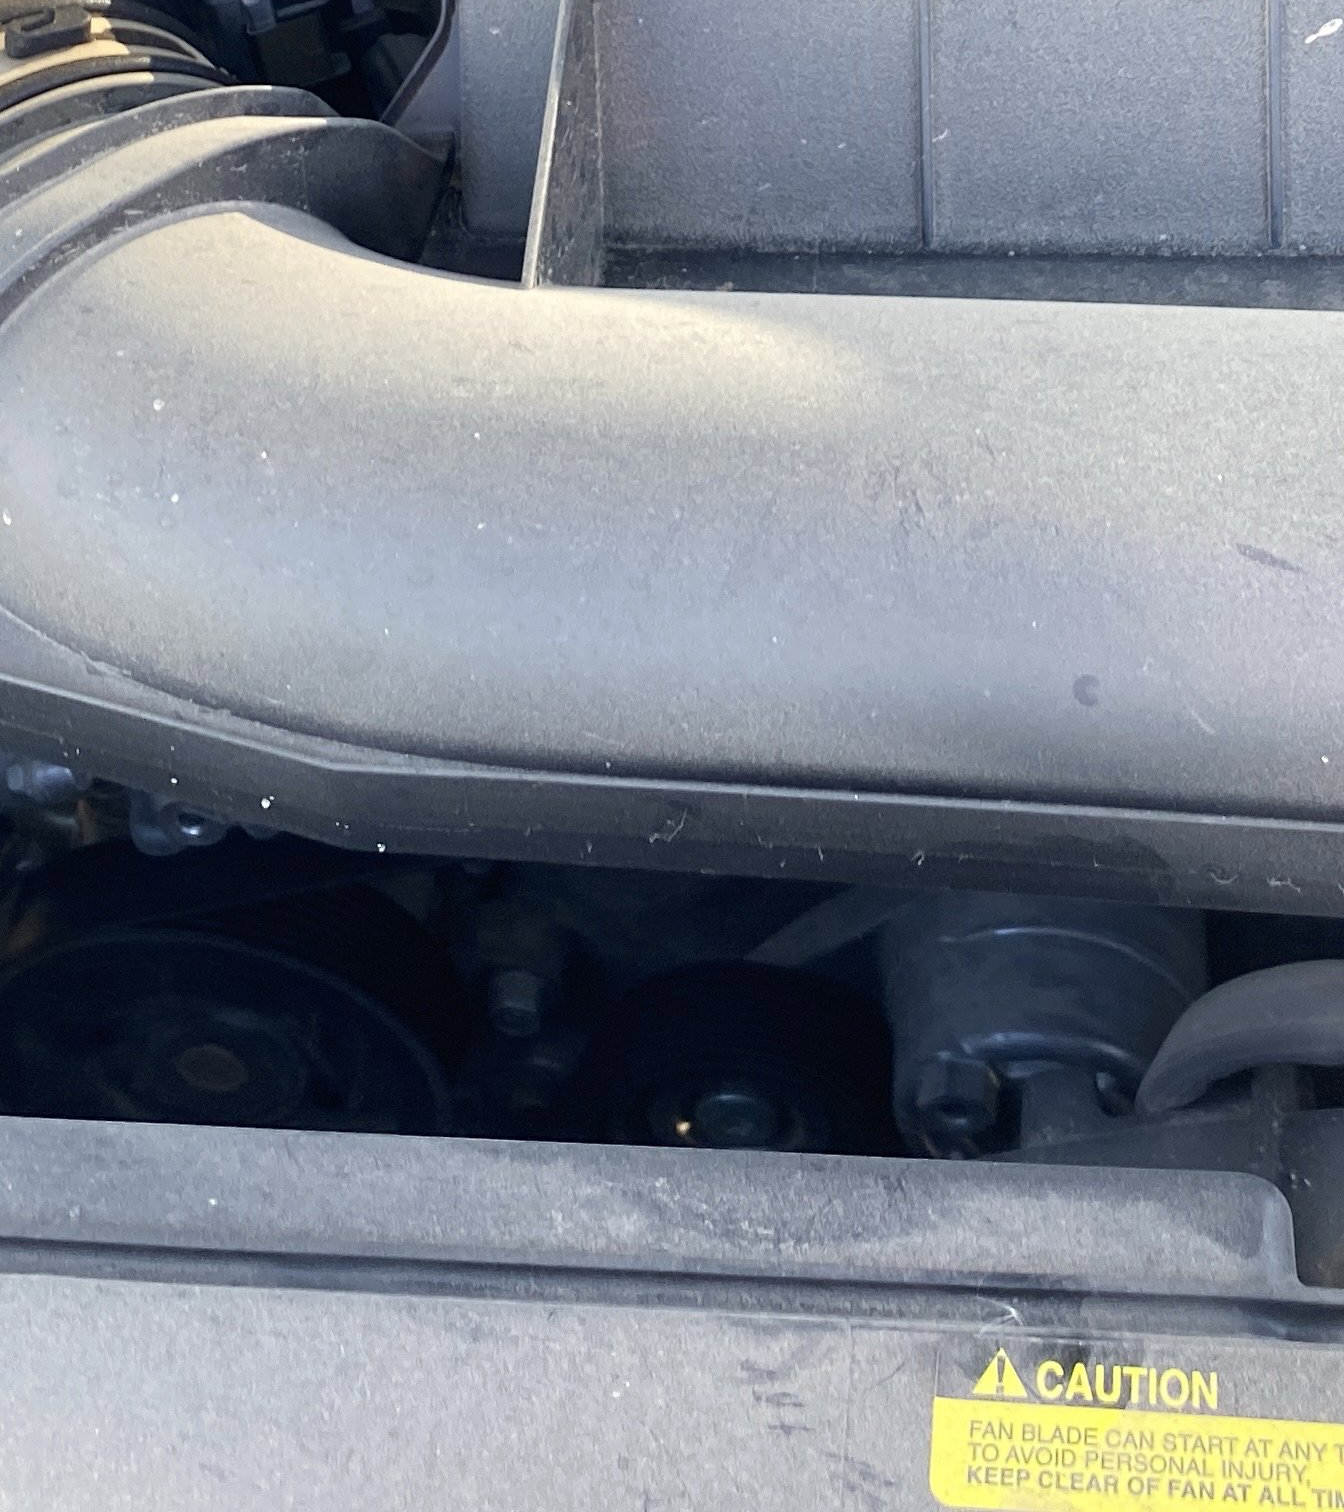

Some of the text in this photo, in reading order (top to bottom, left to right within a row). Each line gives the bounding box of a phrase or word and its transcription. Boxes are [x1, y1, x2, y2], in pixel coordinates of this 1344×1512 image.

[1036, 1359, 1219, 1409] CAUTION
[967, 1442, 1000, 1463] TO
[1005, 1444, 1077, 1467] AVOID
[1085, 1450, 1214, 1477] PERSONAL
[969, 1419, 1014, 1440] FAN
[1021, 1423, 1098, 1446] BLADE
[1105, 1428, 1155, 1449] CAN
[1163, 1431, 1238, 1456] START
[1244, 1438, 1273, 1458] AT
[1279, 1440, 1328, 1462] ANY
[967, 1465, 1031, 1486] KEEP
[1038, 1470, 1119, 1494] CLEAR
[1127, 1475, 1160, 1496] OF
[1168, 1479, 1215, 1501] FAN
[1222, 1483, 1253, 1503] AT
[1259, 1486, 1306, 1508] ALL
